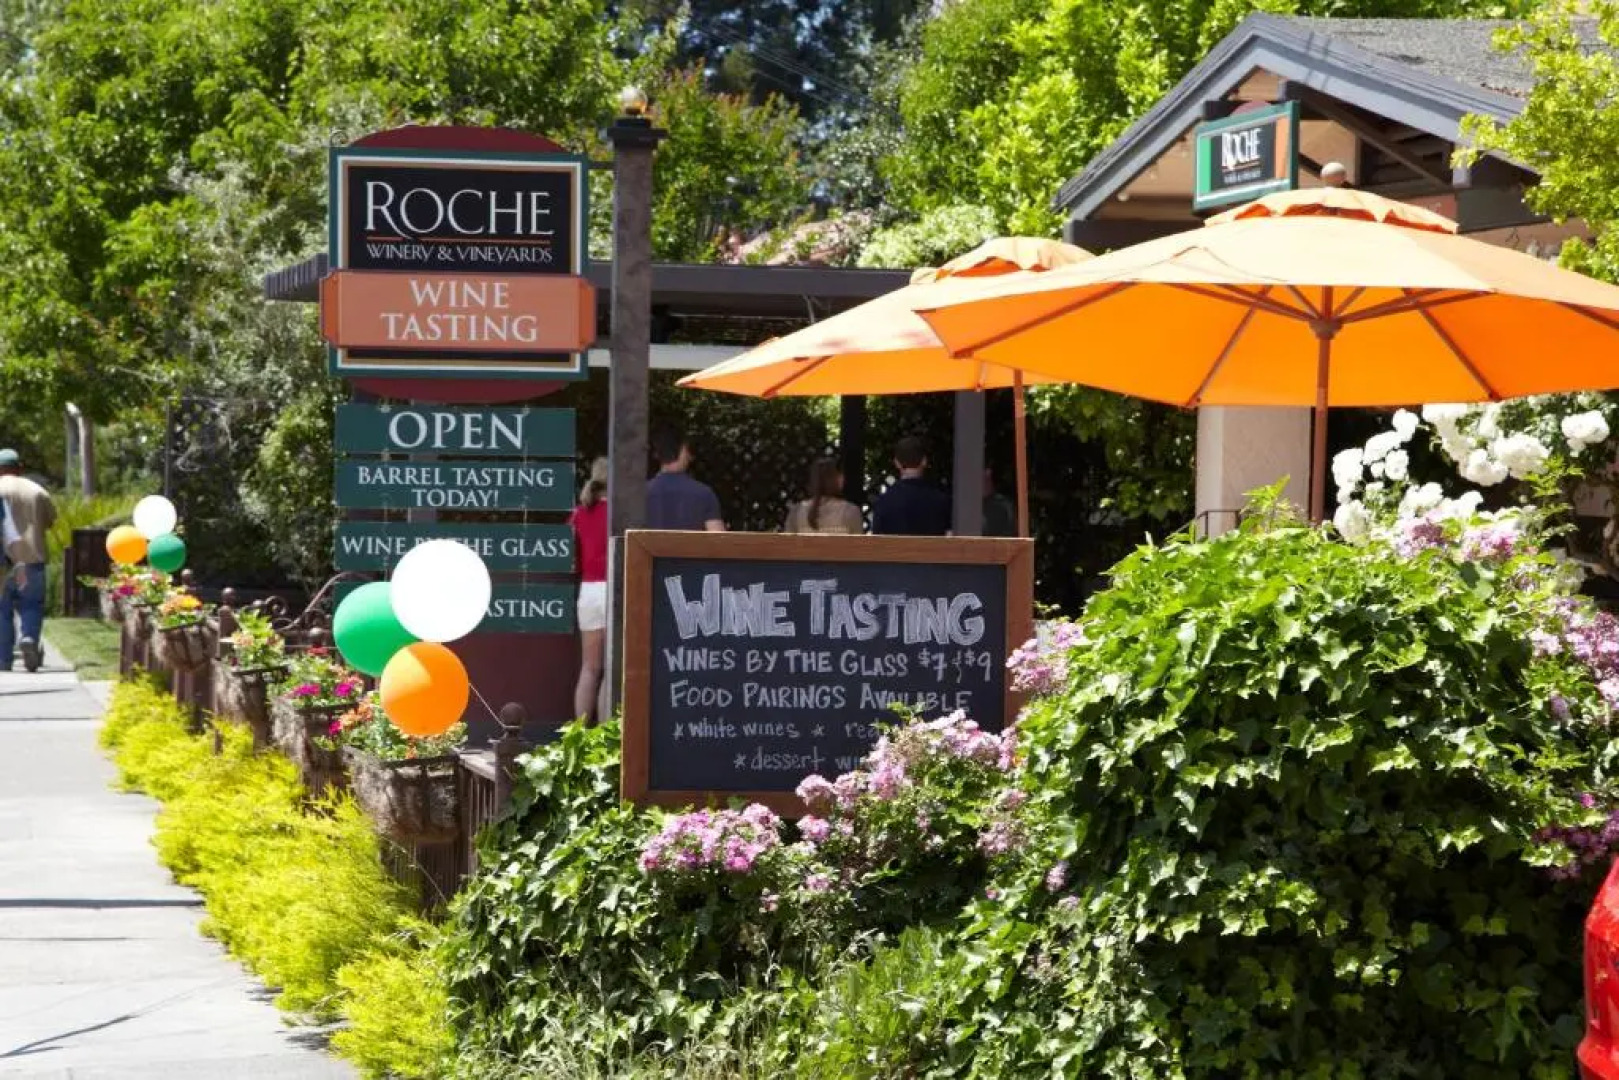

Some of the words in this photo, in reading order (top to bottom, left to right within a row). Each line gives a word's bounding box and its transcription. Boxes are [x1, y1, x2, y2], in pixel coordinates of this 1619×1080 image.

[364, 181, 554, 239] ROCHE
[366, 243, 434, 262] WINERY
[437, 246, 455, 262] &
[456, 246, 553, 264] VINEYARDS
[409, 280, 510, 308] WINE
[380, 313, 538, 342] TASTING
[388, 411, 526, 450] OPEN
[357, 466, 446, 486] BARREL
[452, 467, 555, 487] TASTING
[411, 488, 499, 508] TODAY!
[341, 536, 406, 555] WINE
[500, 538, 570, 557] GLASS
[664, 573, 796, 640] WINE
[800, 578, 985, 646] TASTING
[663, 647, 736, 673] WINES
[746, 649, 779, 673] BY
[784, 650, 833, 674] THE
[840, 650, 909, 677] GLASS
[670, 679, 733, 708] FOOD
[742, 683, 846, 709] PAIRINGS
[688, 717, 738, 739] white
[742, 721, 800, 739] wines
[750, 745, 826, 771] dessert
